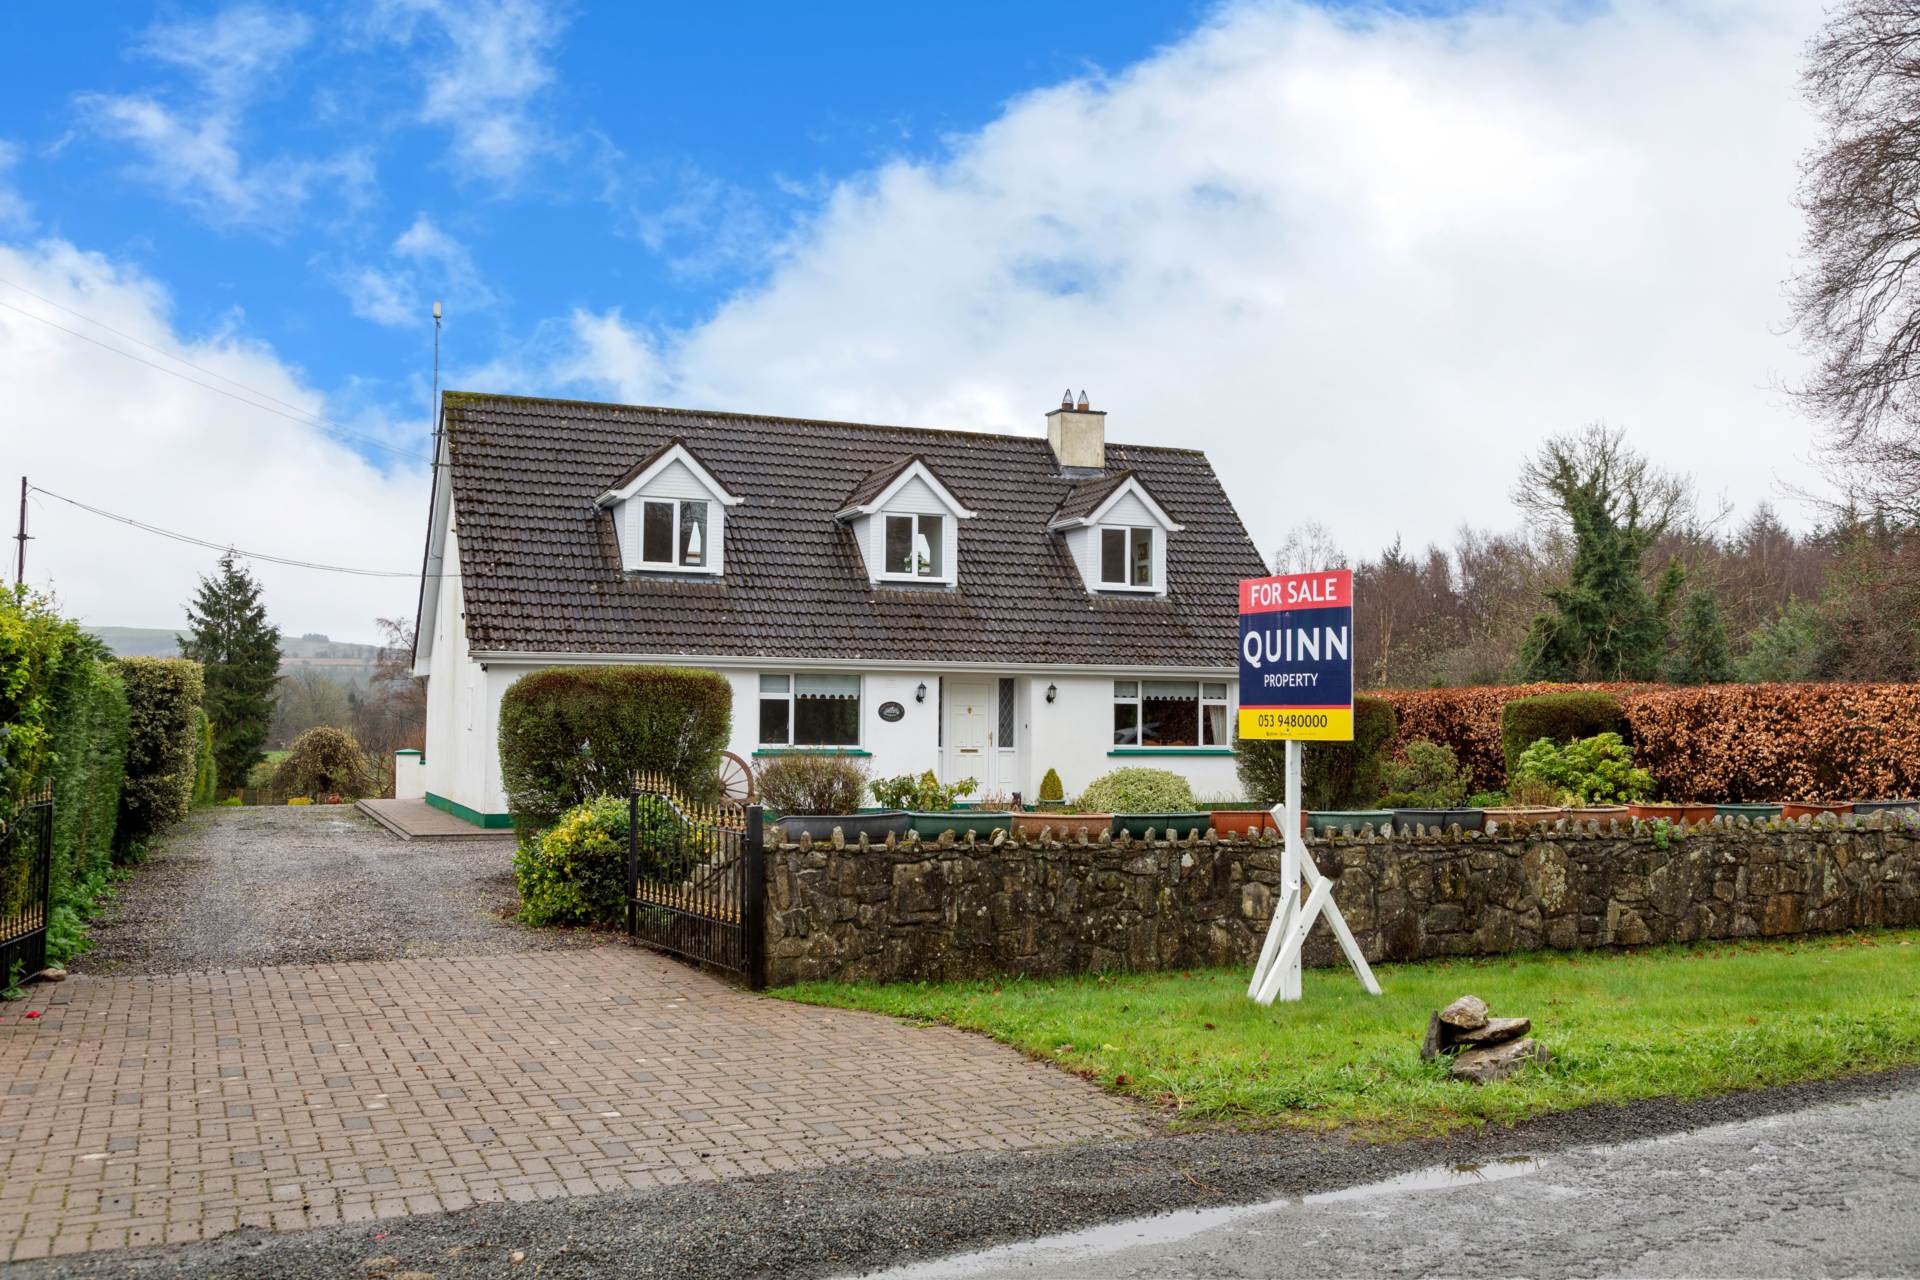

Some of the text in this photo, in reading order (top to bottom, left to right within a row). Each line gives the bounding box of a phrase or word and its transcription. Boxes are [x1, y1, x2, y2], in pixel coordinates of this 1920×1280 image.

[1251, 578, 1338, 607] FOR SALE
[1243, 626, 1348, 669] QUINN
[1264, 673, 1319, 688] PROPERTY
[1258, 714, 1328, 728] 053 9480000
